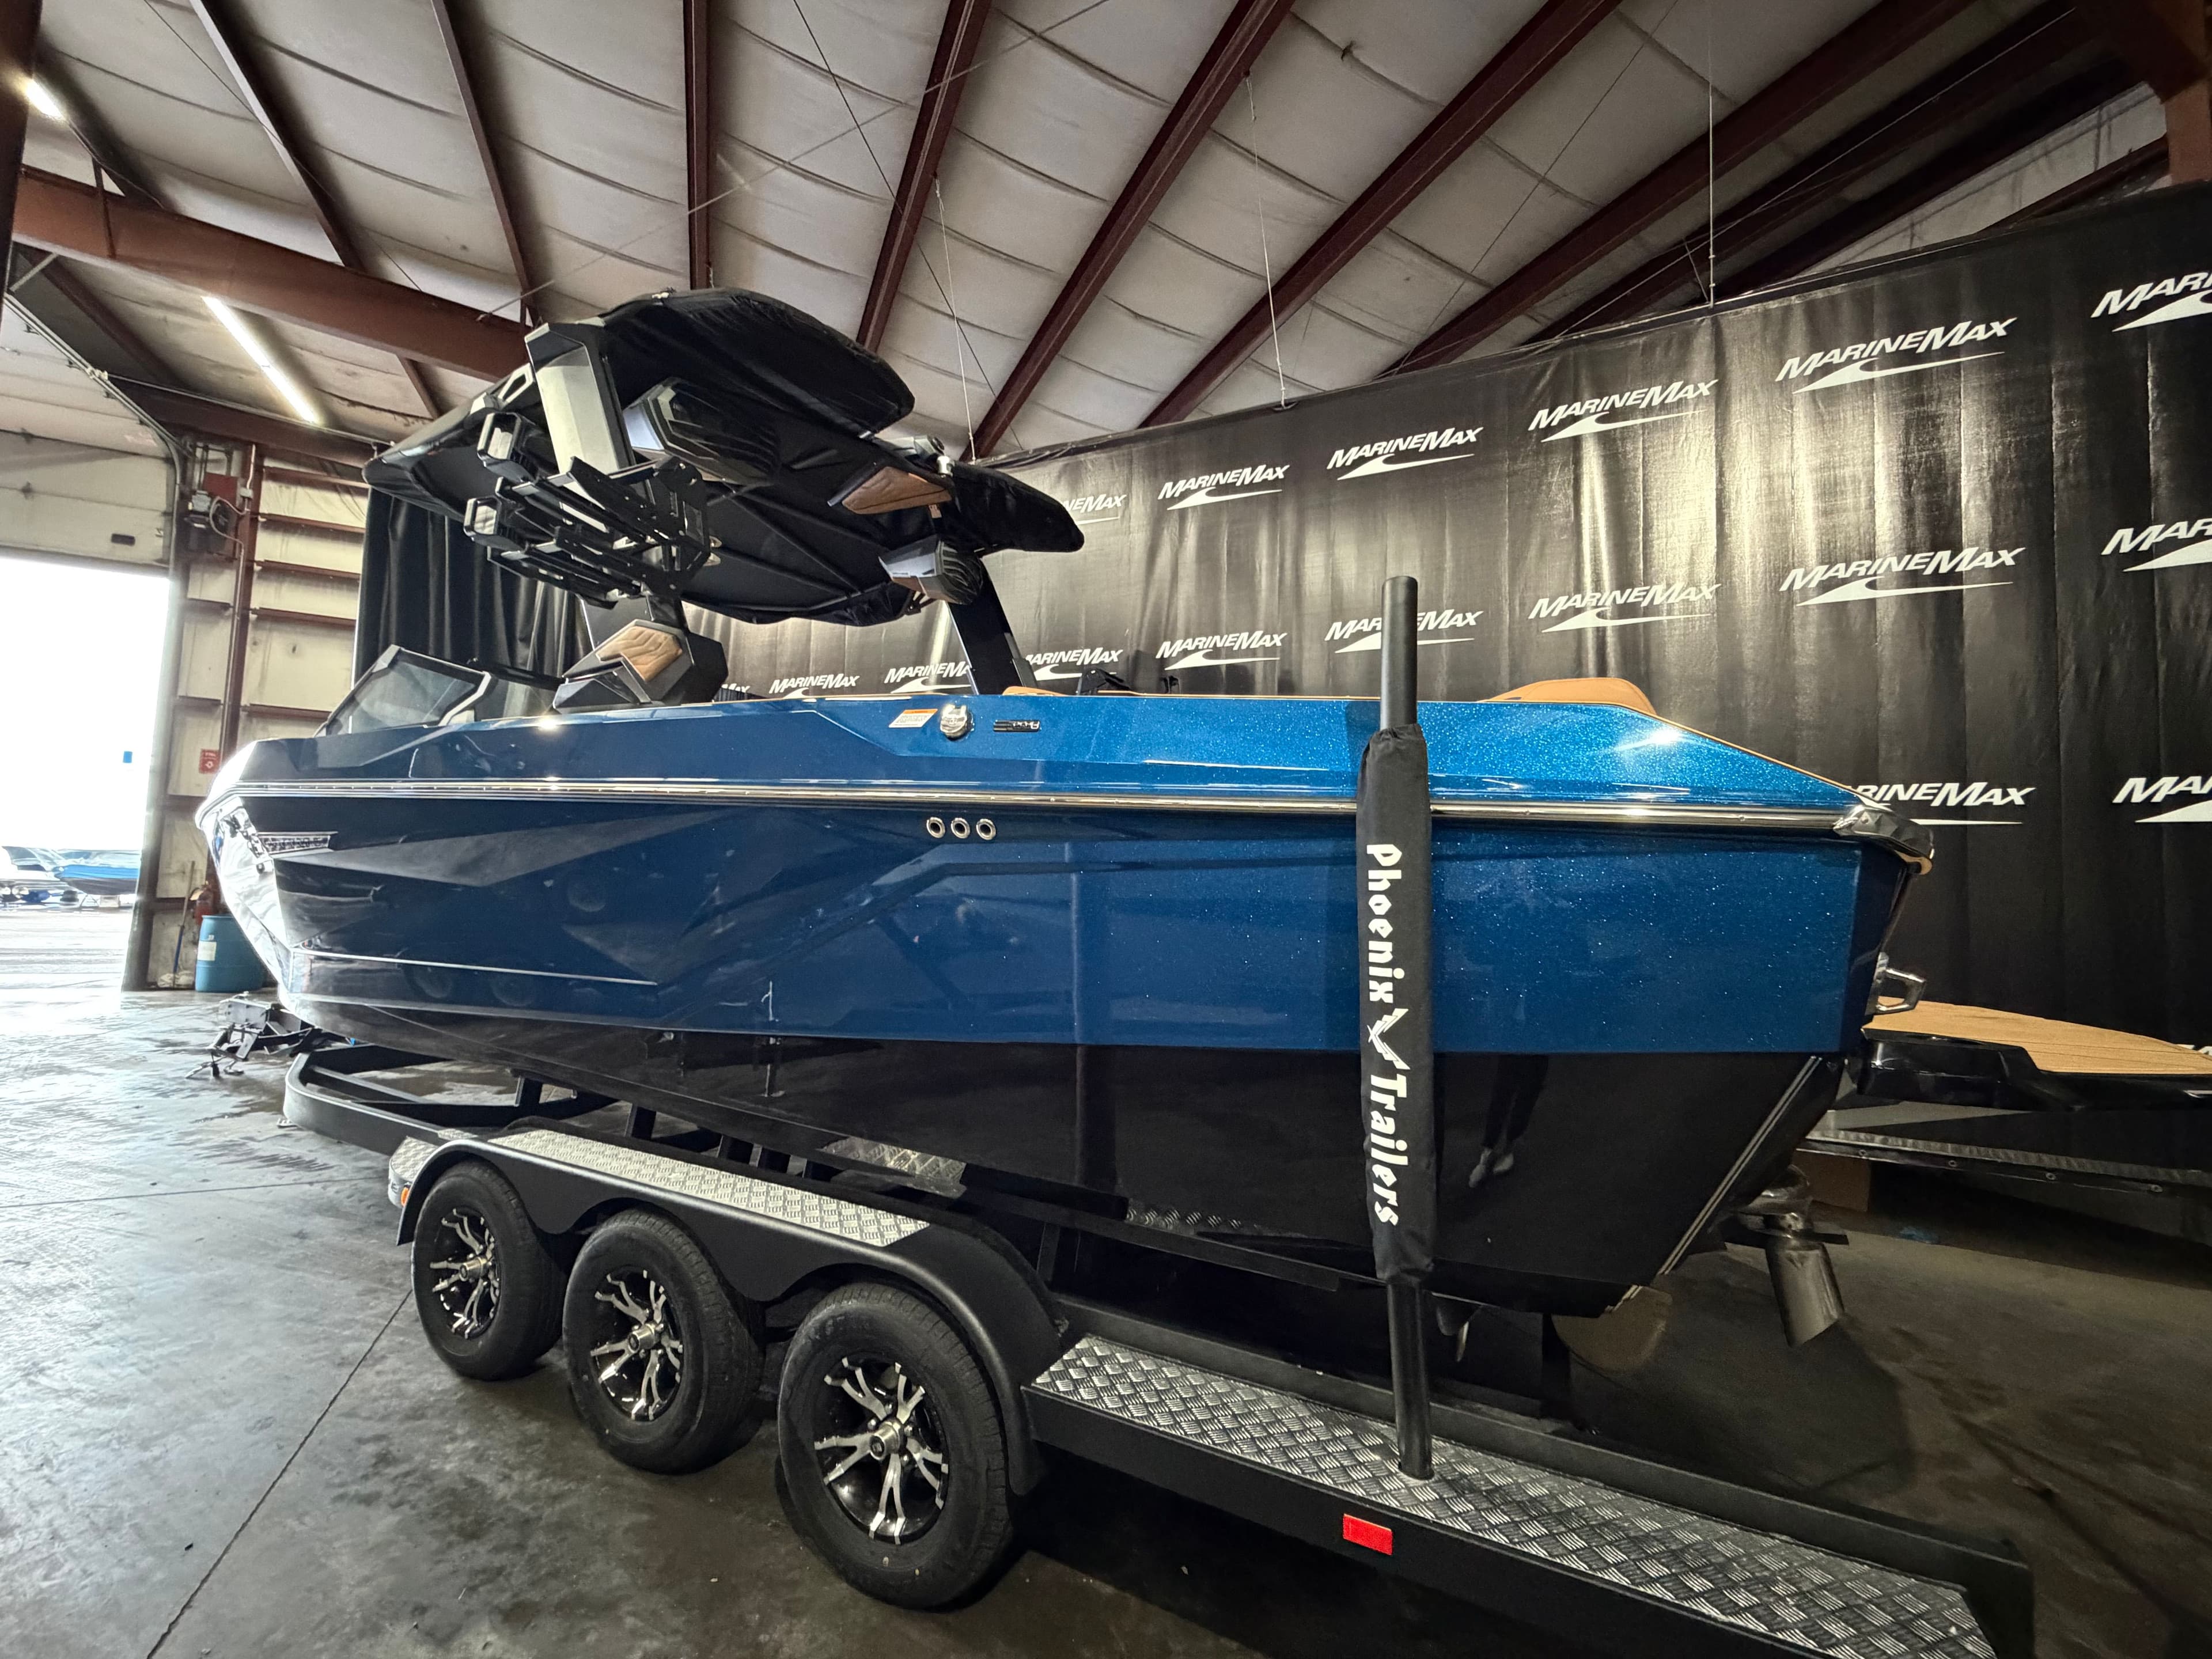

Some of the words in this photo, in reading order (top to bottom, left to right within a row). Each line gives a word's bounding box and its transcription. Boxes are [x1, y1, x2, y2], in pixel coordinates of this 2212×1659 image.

[884, 661, 970, 683] MARINEMA
[1366, 844, 1405, 1003] Phoenix
[1370, 1073, 1408, 1226] Trailers
